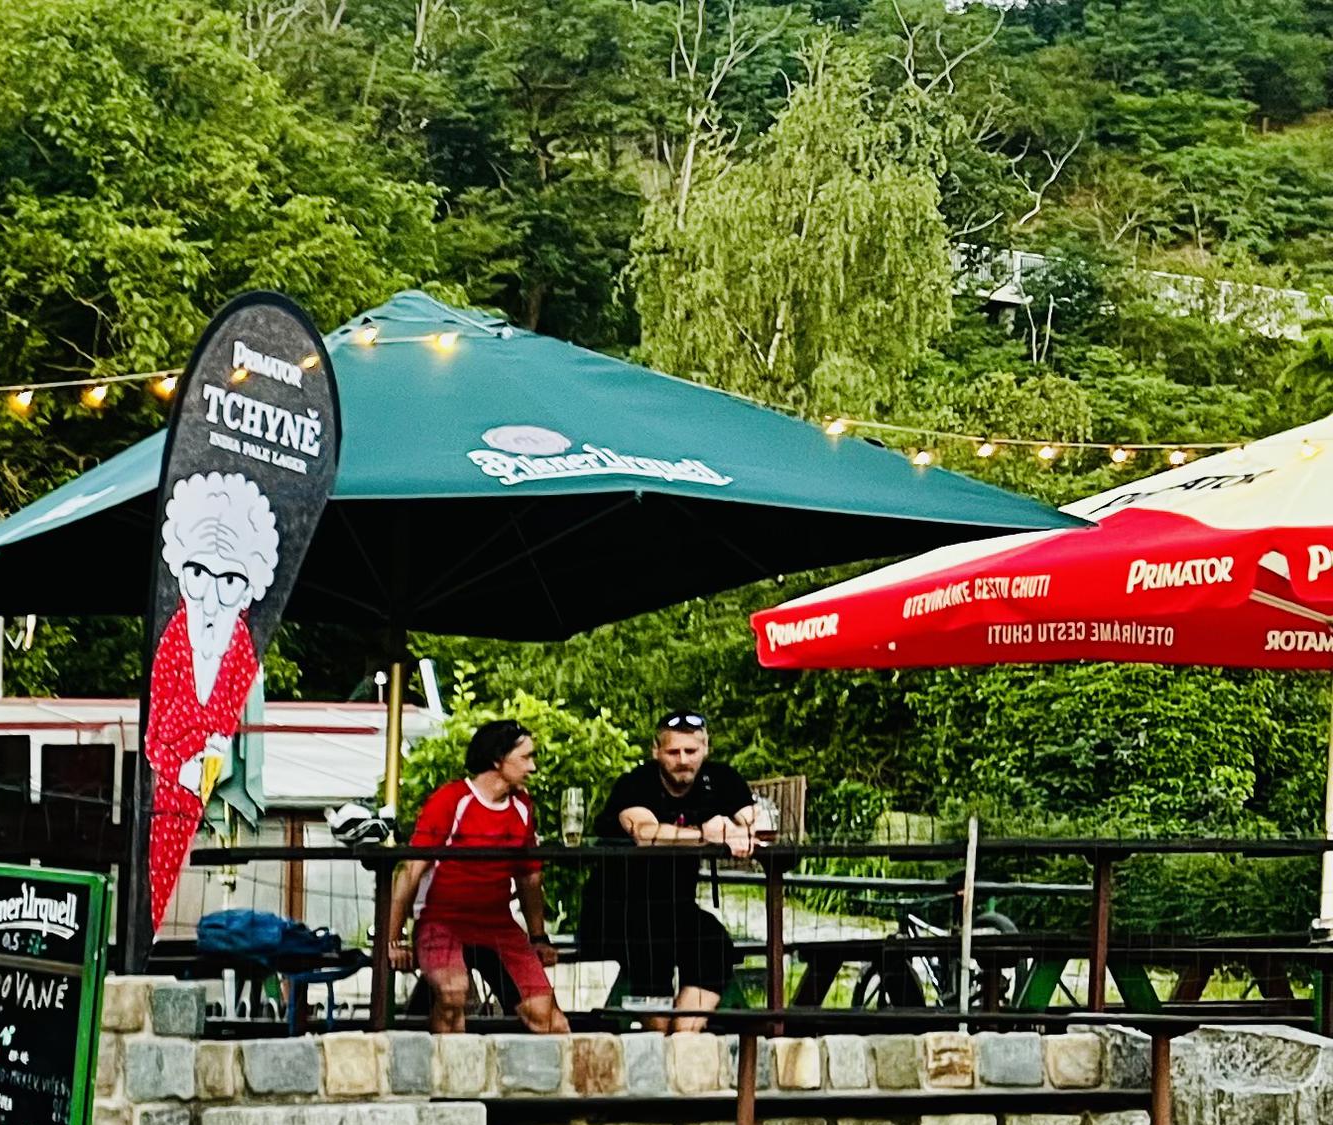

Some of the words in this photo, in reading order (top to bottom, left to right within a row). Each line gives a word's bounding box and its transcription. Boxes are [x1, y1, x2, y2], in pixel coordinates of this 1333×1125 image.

[203, 384, 322, 458] TCHYNĚ
[241, 436, 271, 464] PALE
[974, 577, 1008, 600] CESTU
[1011, 574, 1051, 599] CHUTI
[1126, 556, 1234, 594] PRIMATOR
[766, 613, 839, 652] PRIMATOR
